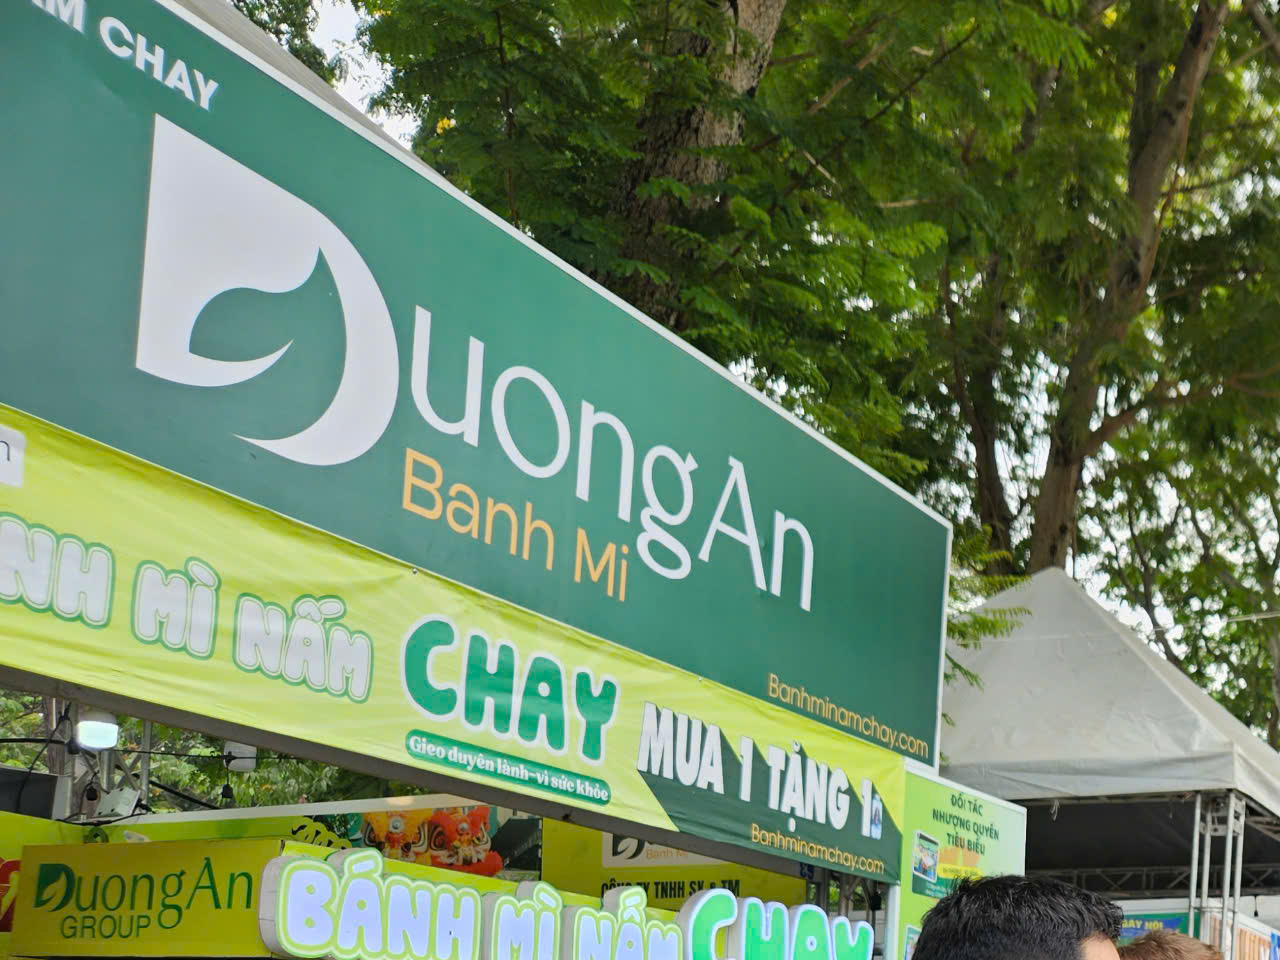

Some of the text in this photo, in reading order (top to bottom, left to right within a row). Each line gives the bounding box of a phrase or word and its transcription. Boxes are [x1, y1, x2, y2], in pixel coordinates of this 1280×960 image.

[99, 16, 219, 111] CHAY
[135, 113, 815, 612] DuongAn
[402, 447, 630, 602] Banh Mi
[0, 511, 621, 766] NH MÌ NẤM CHAY
[768, 673, 930, 759] Banhminamchay.com
[409, 735, 446, 759] Gieo
[448, 744, 495, 771] duyên
[551, 773, 575, 792] sức
[576, 777, 609, 801] khỏe
[638, 700, 873, 839] MUA 1 TẶNG 1
[932, 808, 971, 832] NHƯỢNG
[951, 792, 984, 816] ĐỐI TÁC
[751, 823, 885, 875] Banhminamchay.com
[946, 832, 986, 855] TIÊU BIỂU
[33, 856, 253, 930] DuongAn
[654, 881, 685, 899] TNHH
[60, 914, 151, 939] GROUP
